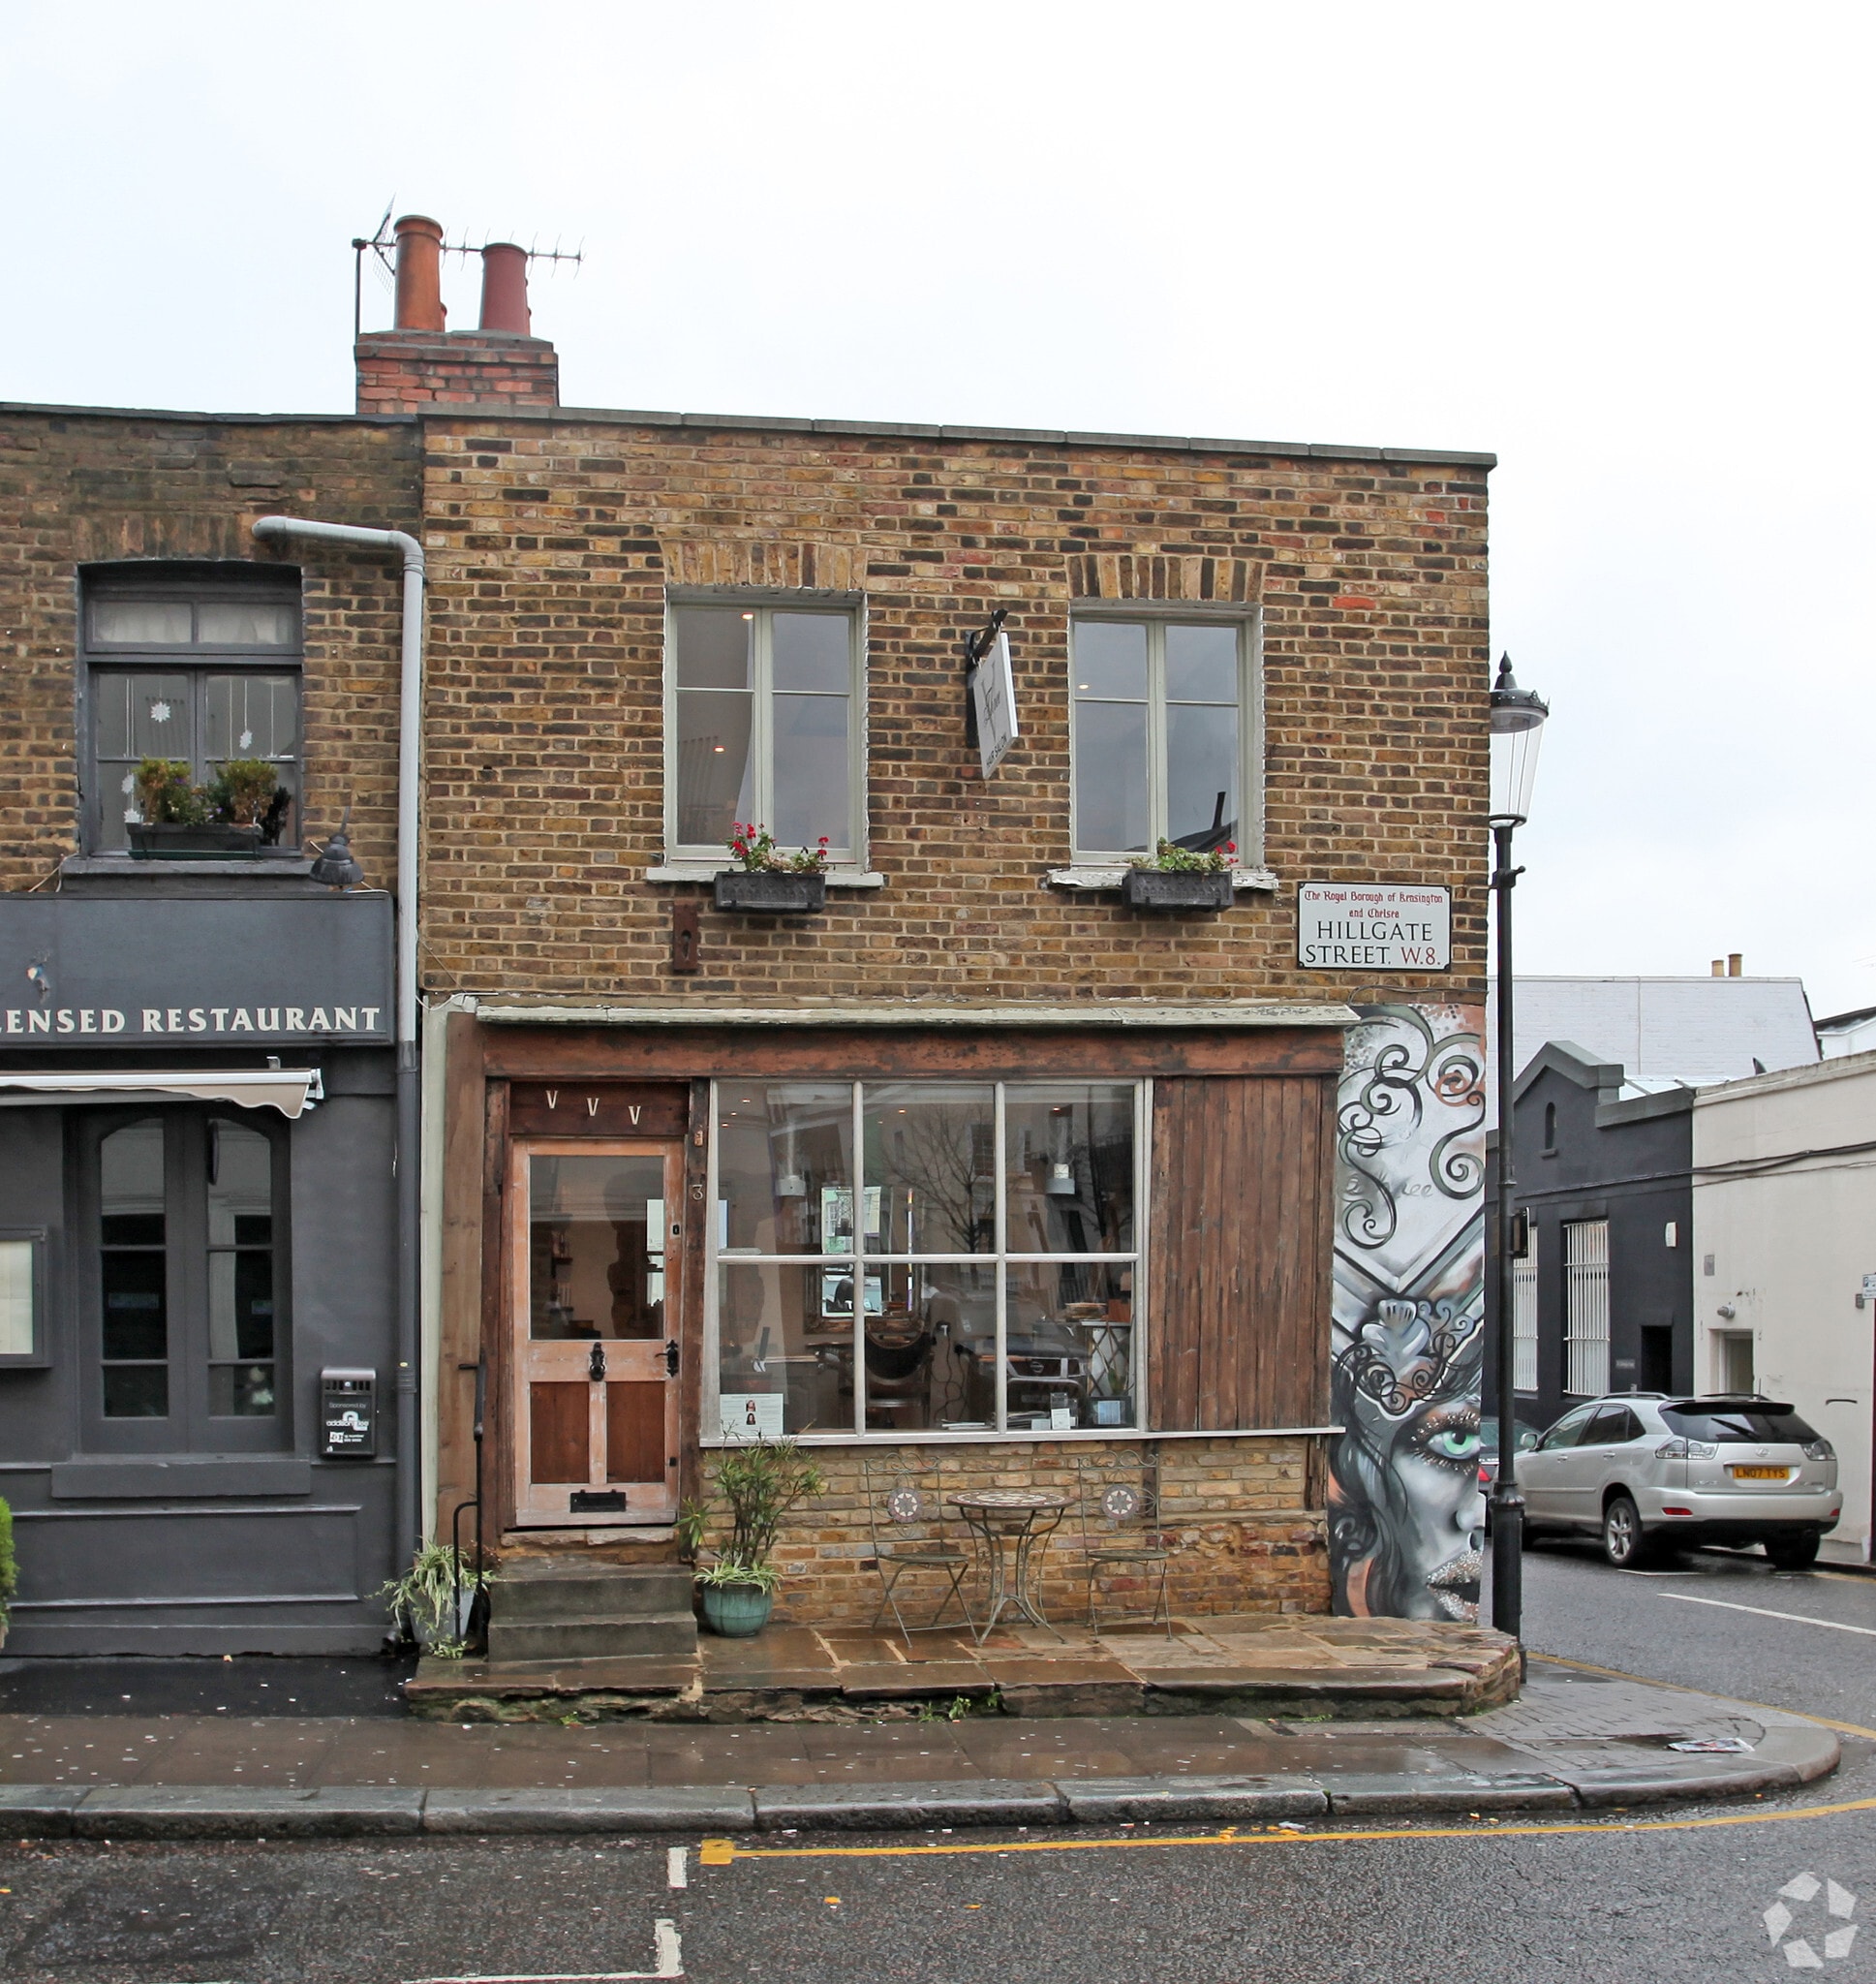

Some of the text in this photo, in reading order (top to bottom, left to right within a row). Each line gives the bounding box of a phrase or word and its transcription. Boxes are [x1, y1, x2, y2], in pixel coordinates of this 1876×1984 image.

[1304, 890, 1443, 907] The Royal Borough of Kensington
[1349, 909, 1399, 918] and Chelsea
[1317, 920, 1433, 942] HILLGATE
[1306, 945, 1441, 966] STREET. W.8.
[0, 1007, 381, 1034] ENSED RESTAURANT
[692, 1184, 703, 1200] 3
[1736, 1467, 1786, 1478] LN07 TYS
